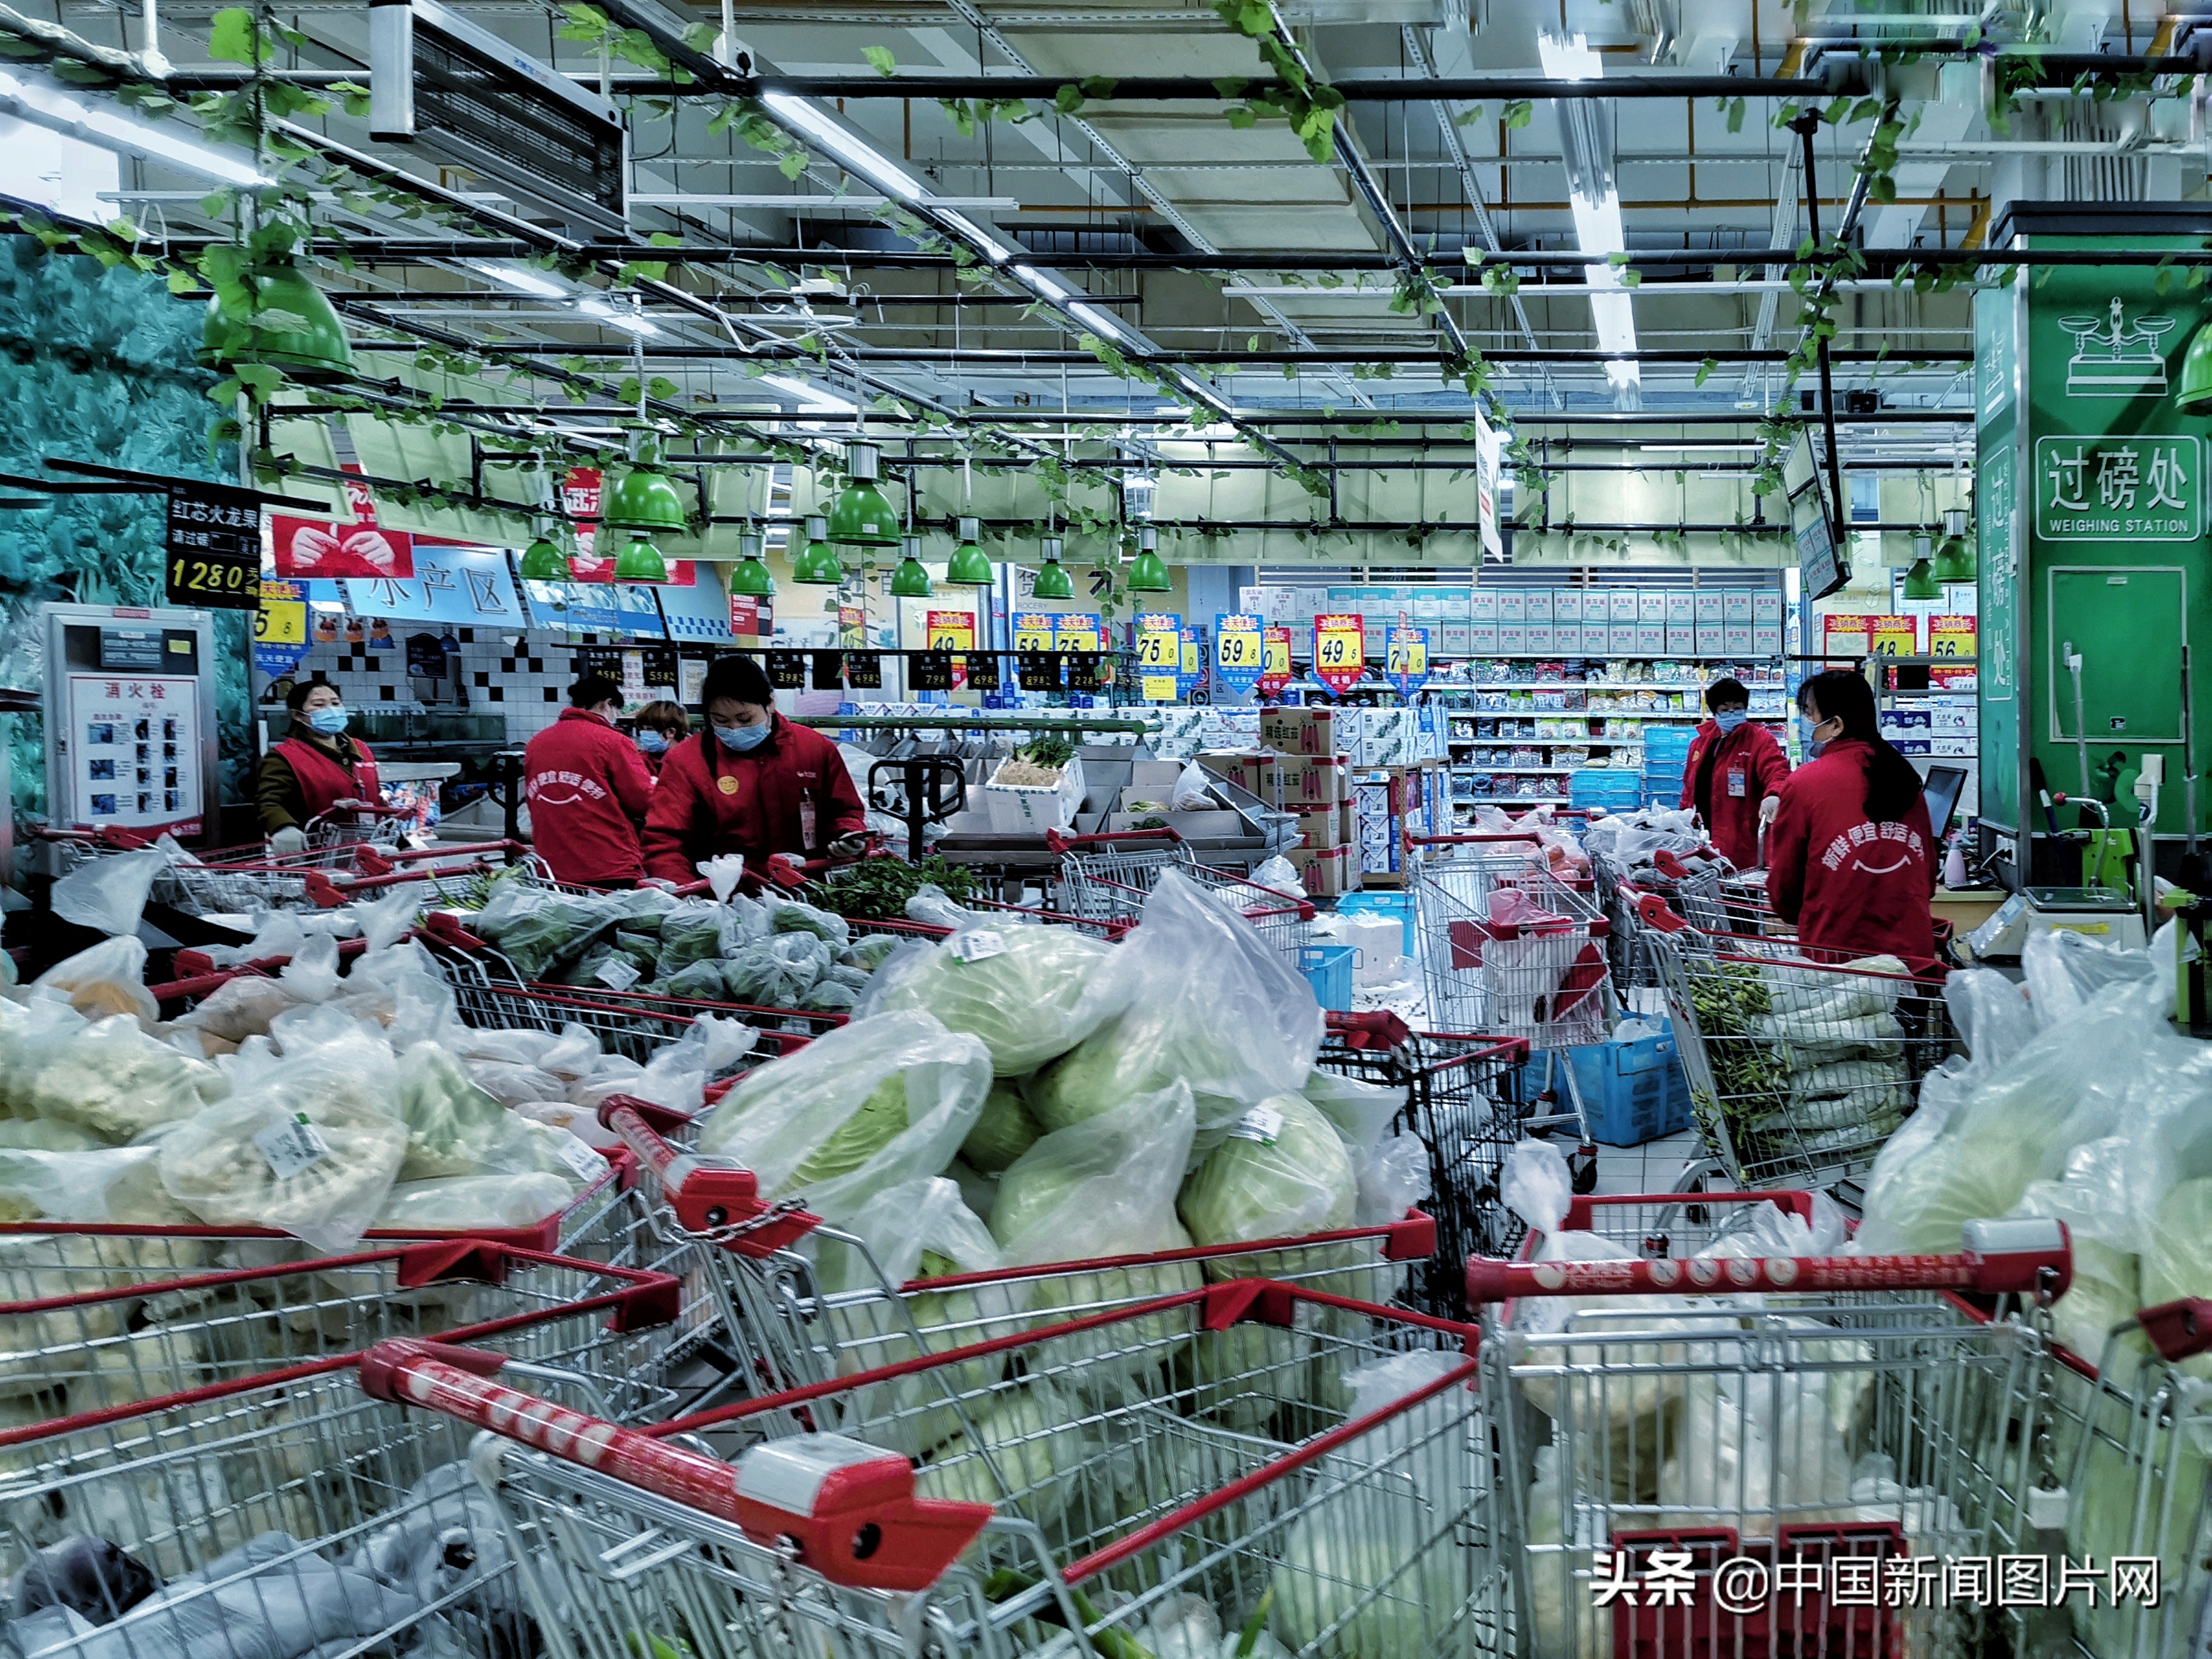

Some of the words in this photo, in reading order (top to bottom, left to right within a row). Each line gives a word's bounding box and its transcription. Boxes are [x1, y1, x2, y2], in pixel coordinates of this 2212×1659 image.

[2048, 445, 2188, 511] 过磅处
[172, 499, 258, 529] 红芯火龙果
[2049, 519, 2120, 533] WEIGHING
[2125, 519, 2188, 533] STATION
[173, 558, 243, 592] 1280
[263, 584, 301, 596] 天便宜
[1141, 618, 1175, 627] 天天便宜
[1224, 618, 1257, 627] 天天便宜
[1831, 620, 1866, 629] 促销商品
[1874, 620, 1910, 629] 促销商品
[1934, 620, 1971, 629] 促销商品
[1140, 638, 1161, 662] 75
[1168, 648, 1175, 659] 0
[1221, 639, 1243, 662] 59
[1250, 648, 1256, 660] 8
[1322, 640, 1344, 663] 49
[1351, 649, 1357, 660] 5
[1330, 675, 1351, 685] 促销
[105, 682, 166, 700] 消火栓
[1822, 834, 1851, 871] 新鲜
[1847, 820, 1879, 847] 便宜
[1879, 821, 1909, 843] 舒适
